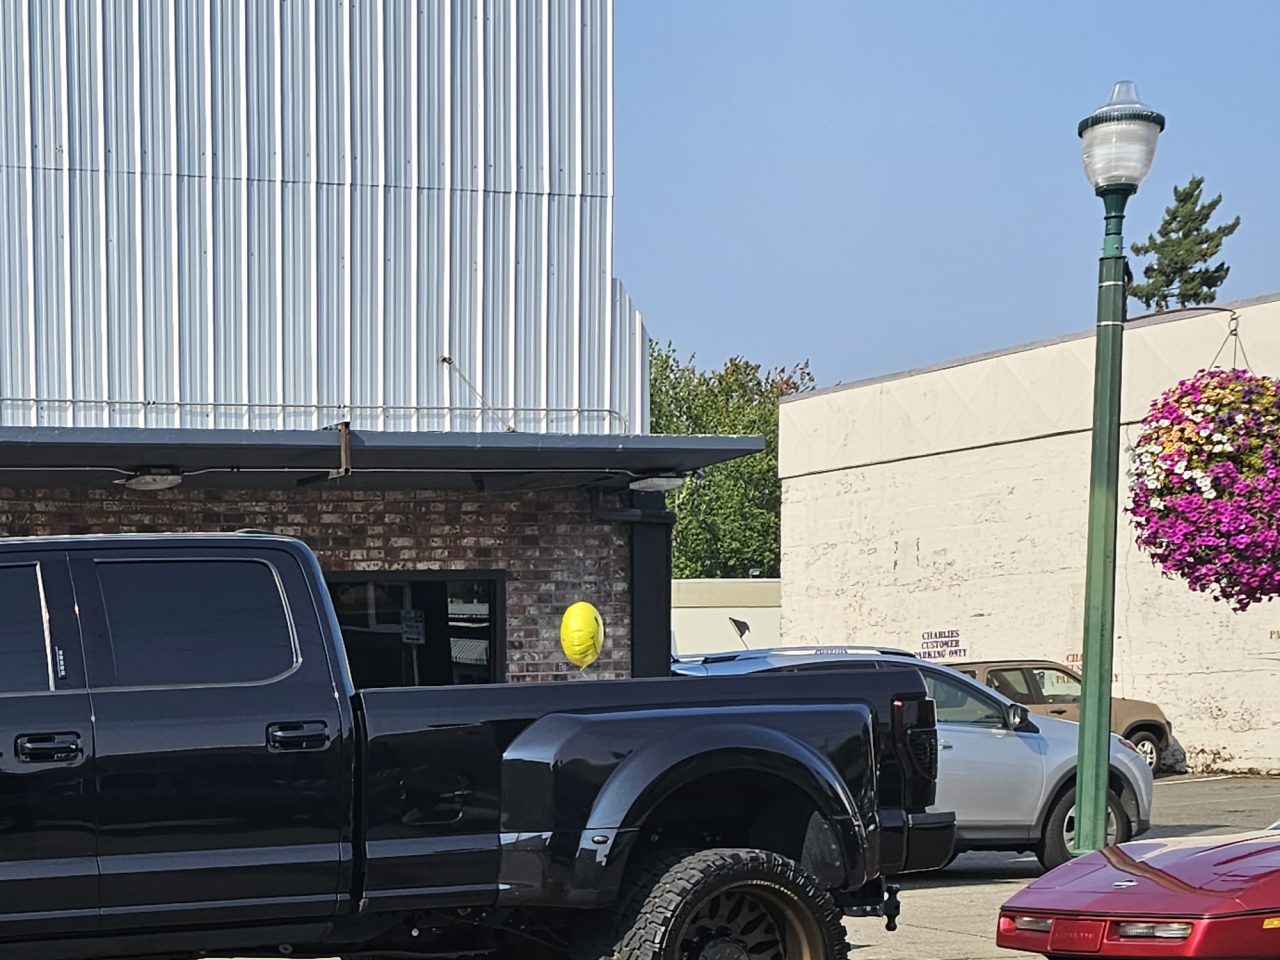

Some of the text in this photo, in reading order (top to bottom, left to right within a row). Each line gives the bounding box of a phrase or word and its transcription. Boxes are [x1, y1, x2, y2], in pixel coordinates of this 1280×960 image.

[921, 630, 960, 640] CHARLIES
[921, 640, 960, 649] CUSTOMER
[948, 648, 967, 657] ONLY
